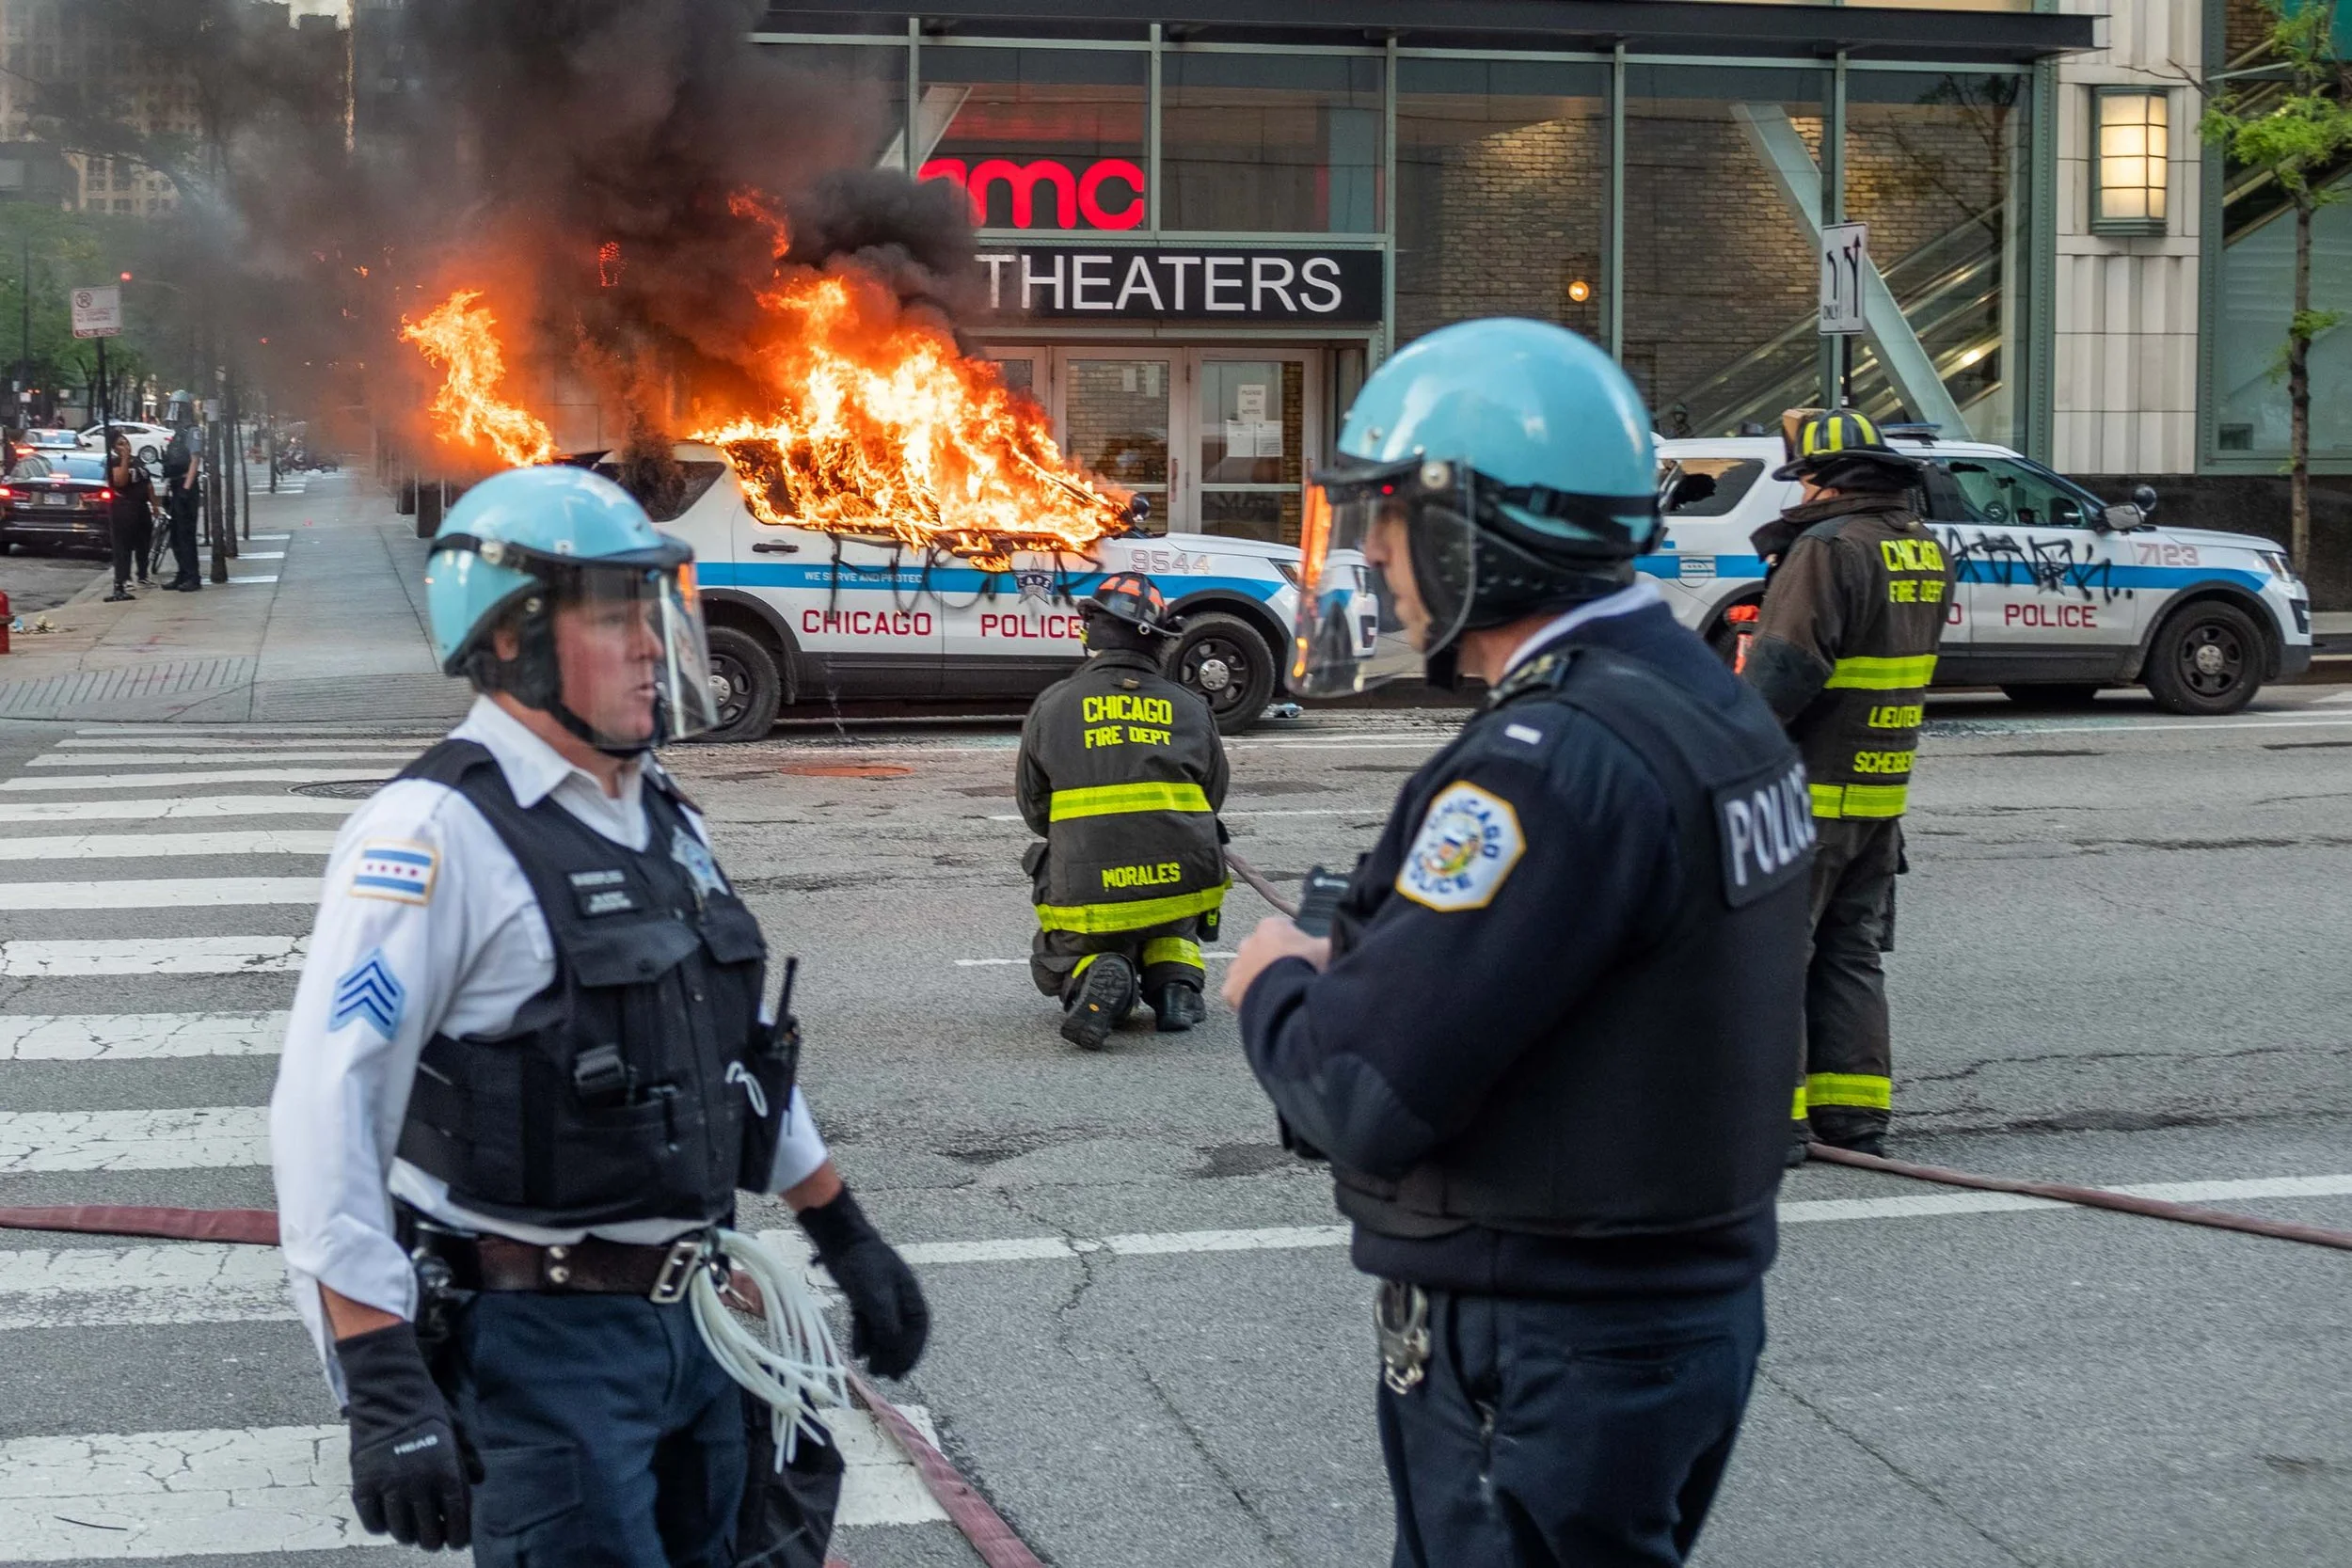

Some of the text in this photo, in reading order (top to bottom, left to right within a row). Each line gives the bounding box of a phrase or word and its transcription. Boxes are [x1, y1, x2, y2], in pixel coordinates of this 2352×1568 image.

[974, 254, 1343, 312] THEATERS
[1131, 549, 1211, 575] 9544
[2137, 543, 2199, 565] 7123
[804, 571, 821, 581] WE
[803, 610, 1083, 639] CHICAGO POLICE
[2005, 604, 2097, 628] POLICE
[1082, 695, 1173, 725] CHICAGO
[1084, 725, 1171, 749] FIRE DEPT
[1102, 862, 1181, 888] MORALES
